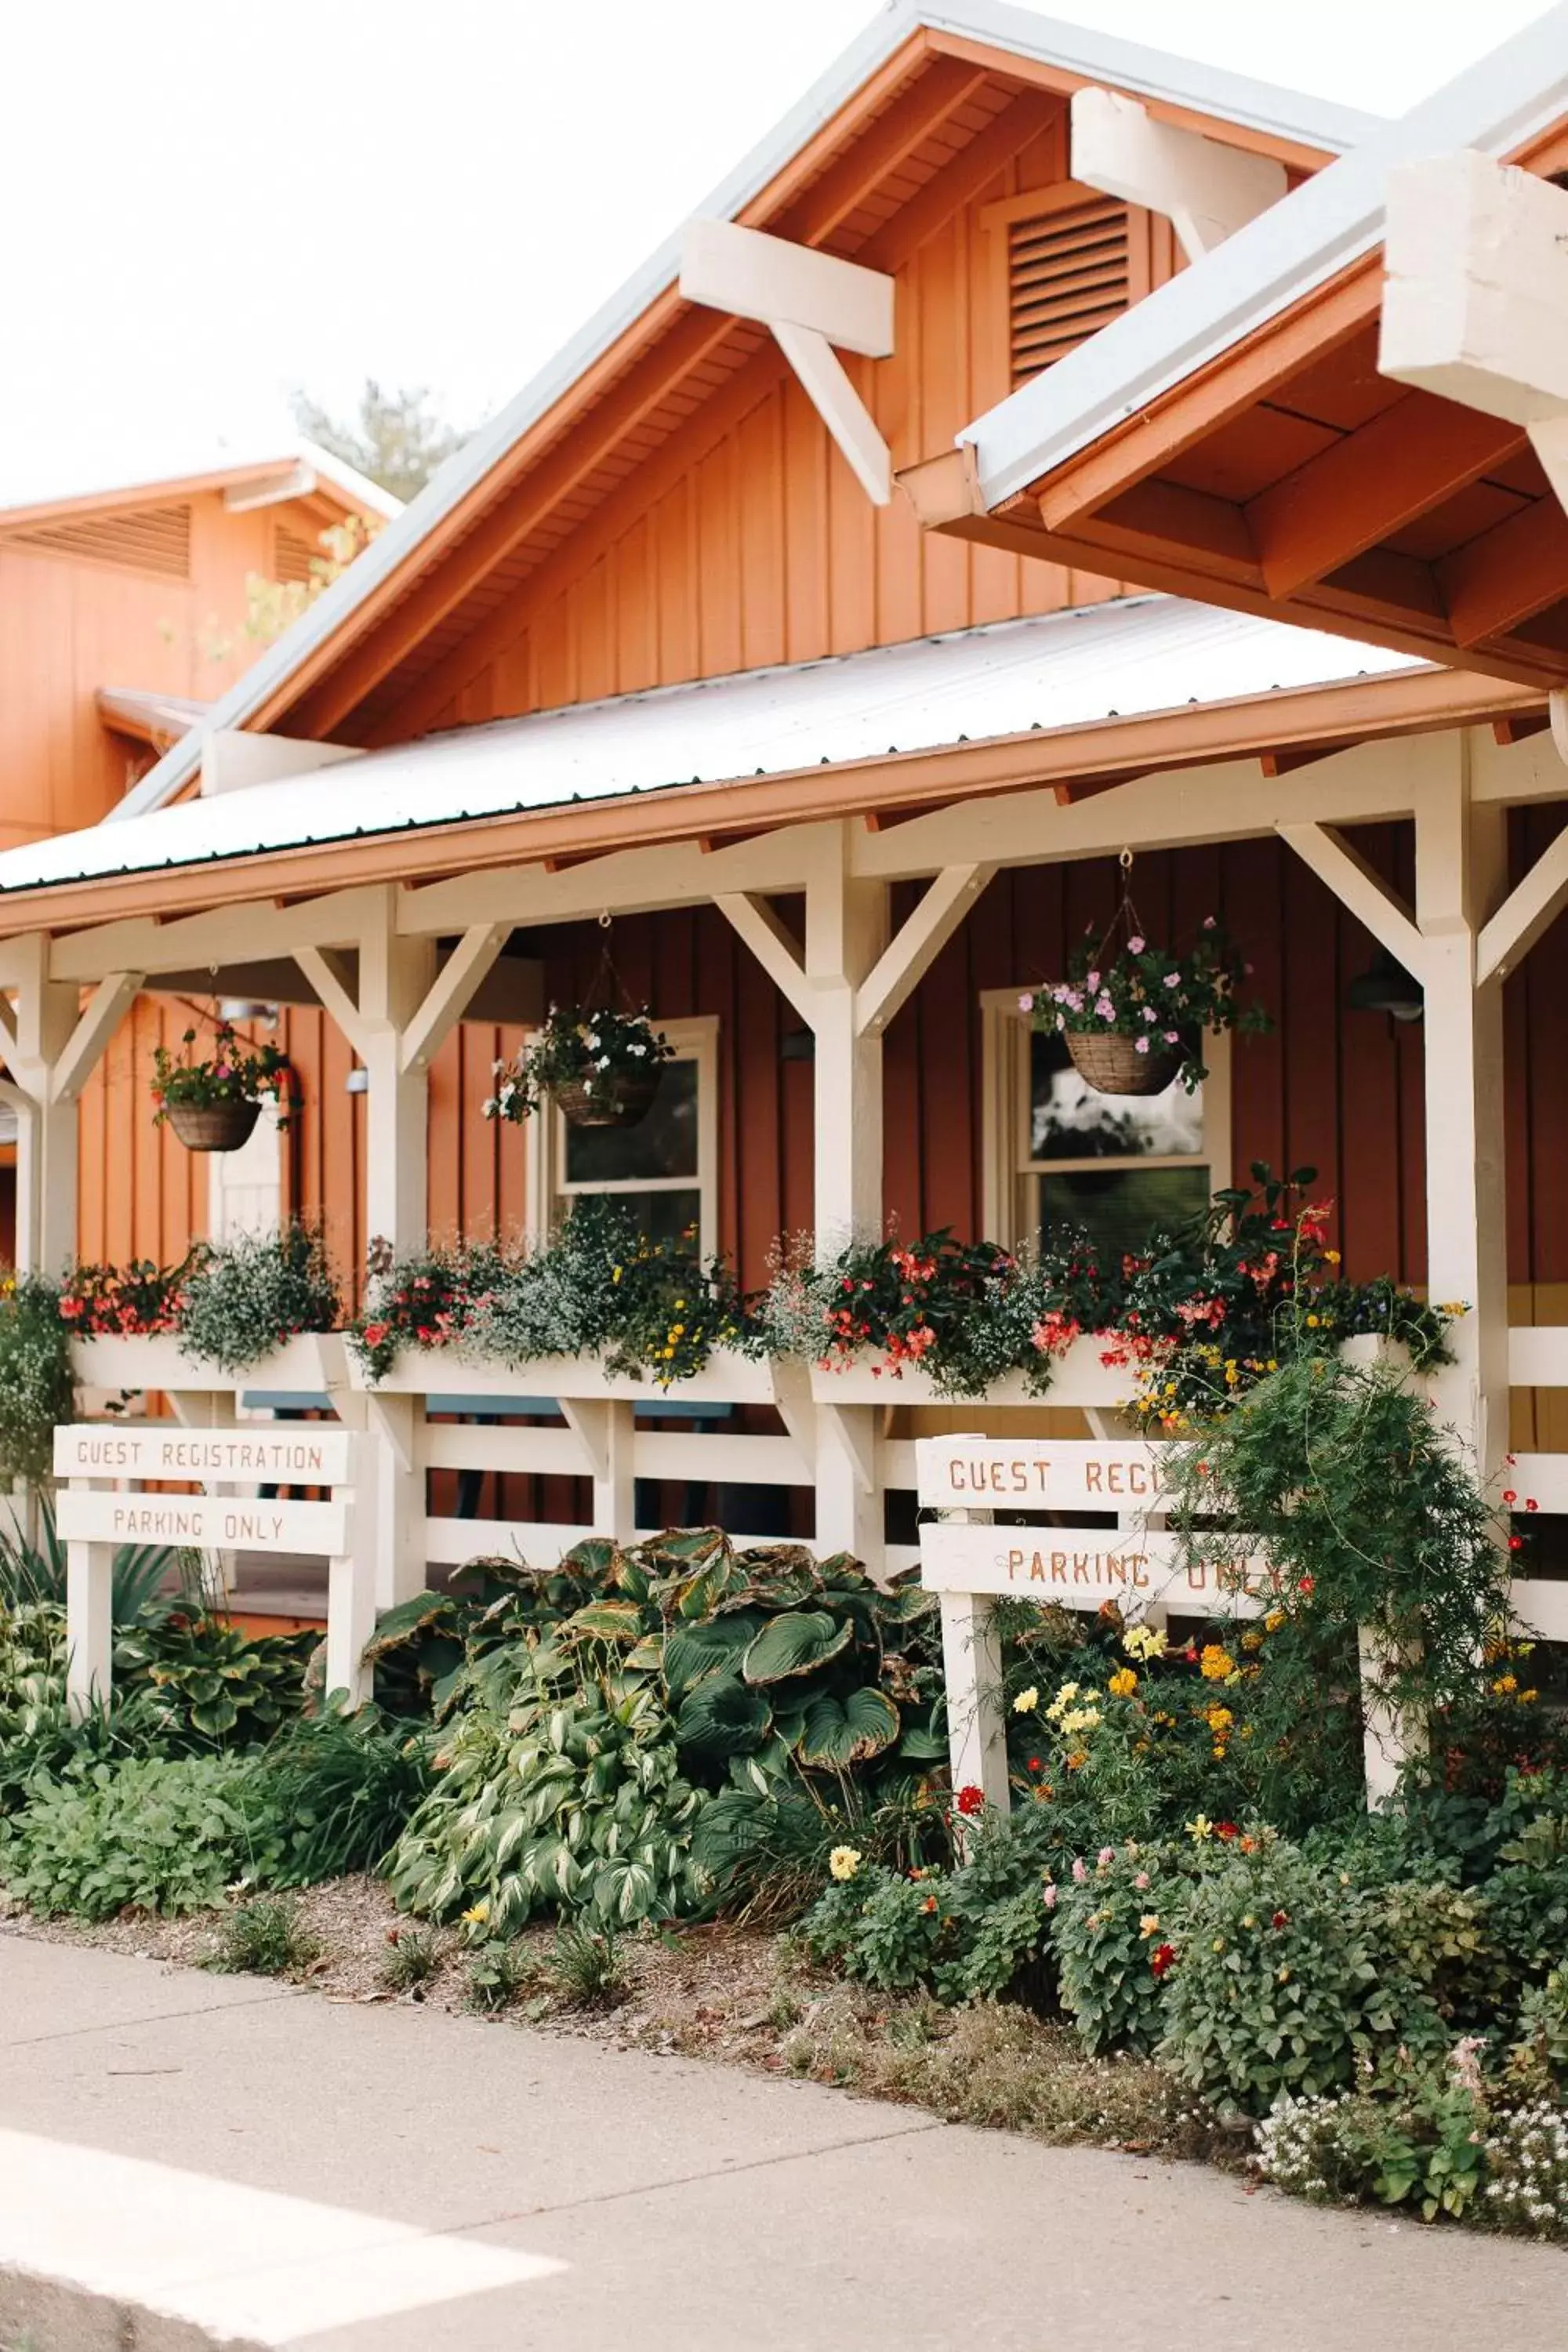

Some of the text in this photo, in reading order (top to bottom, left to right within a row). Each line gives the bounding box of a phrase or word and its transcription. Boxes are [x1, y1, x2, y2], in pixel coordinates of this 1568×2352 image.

[78, 1441, 322, 1470] GUEST REGISTRATION
[949, 1459, 1051, 1492] GUEST
[114, 1509, 284, 1540] PARKING ONLY
[1008, 1549, 1150, 1588] PARKING
